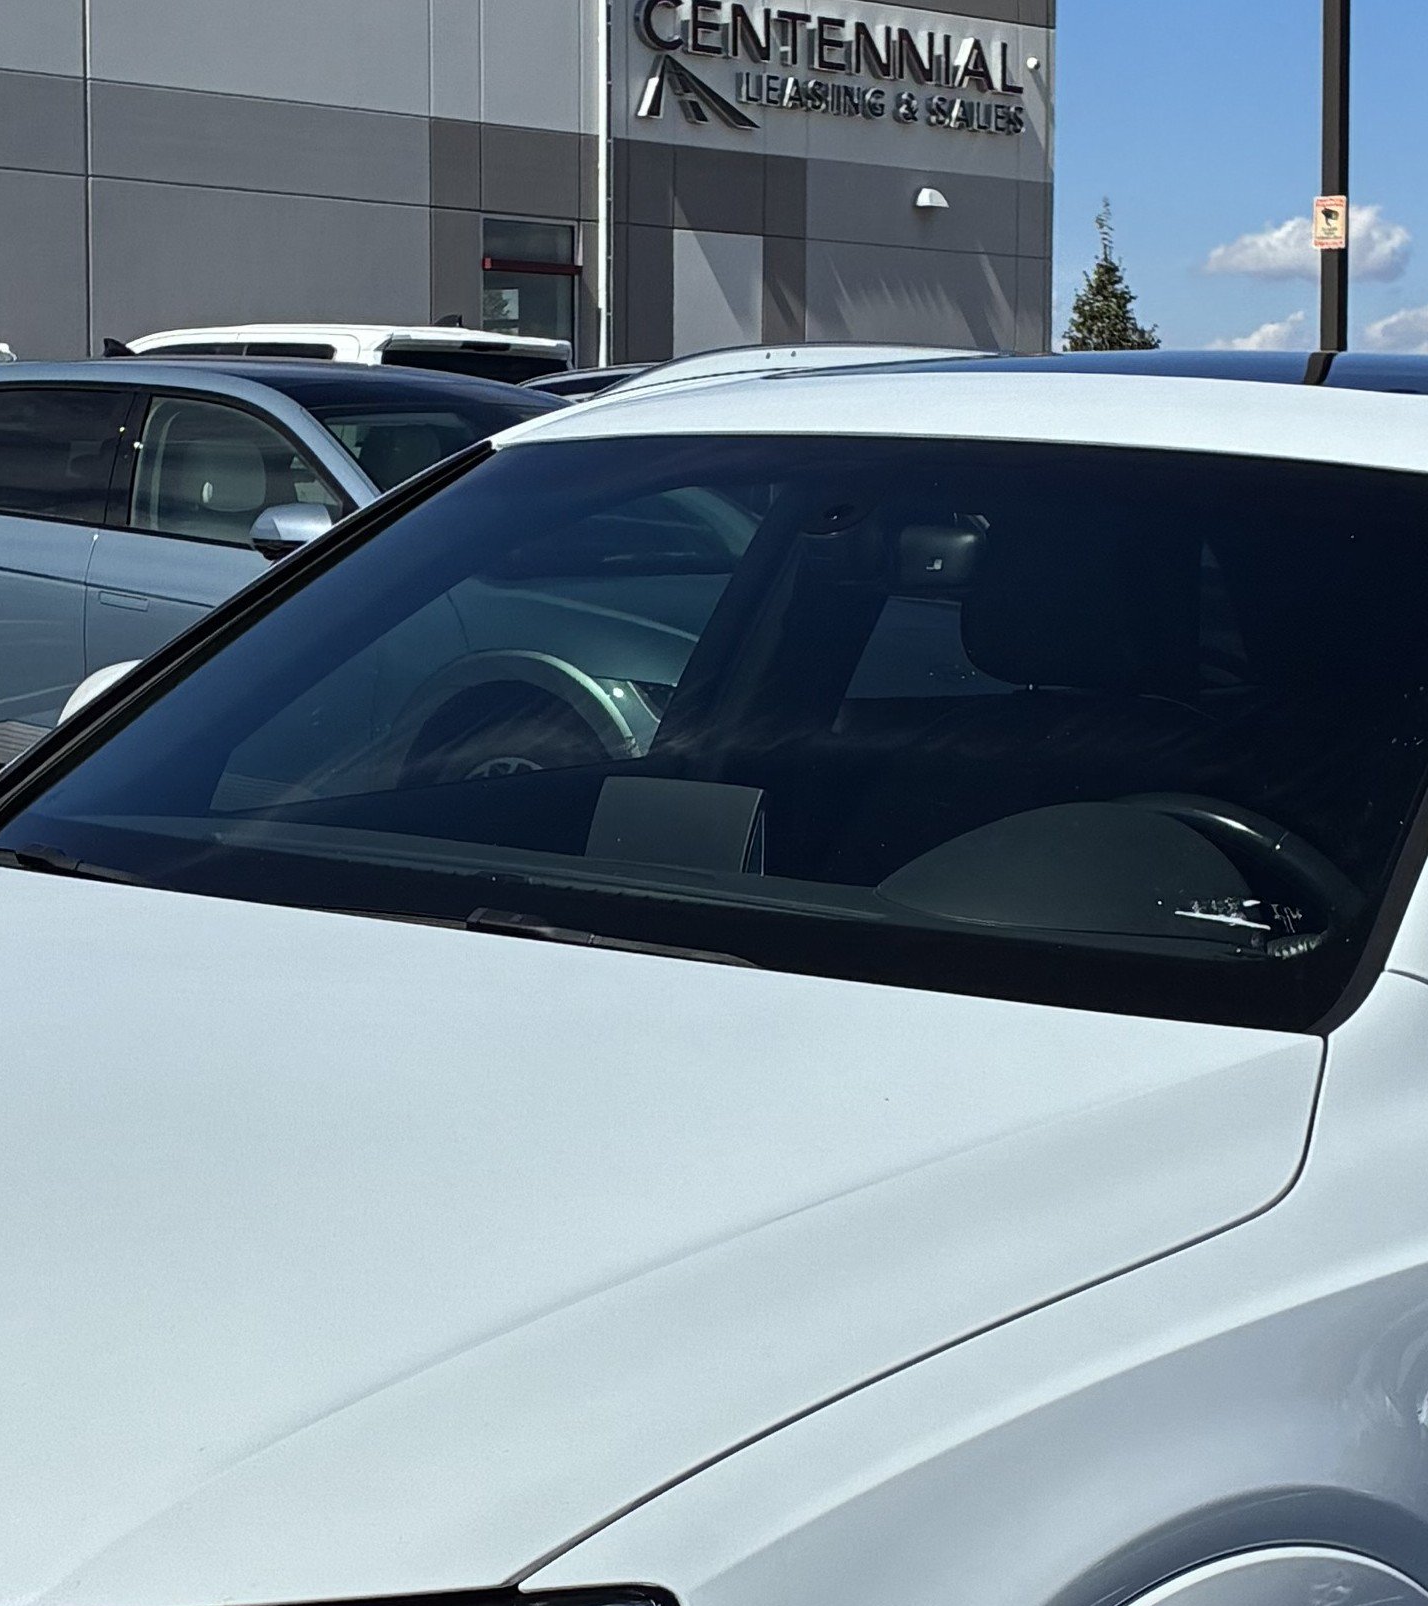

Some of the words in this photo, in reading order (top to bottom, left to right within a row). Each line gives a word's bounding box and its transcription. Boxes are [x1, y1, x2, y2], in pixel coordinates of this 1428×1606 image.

[636, 0, 1024, 94] CENTENNIAL
[738, 71, 886, 120] LEASING
[895, 91, 920, 124] &
[927, 95, 1026, 135] SALES
